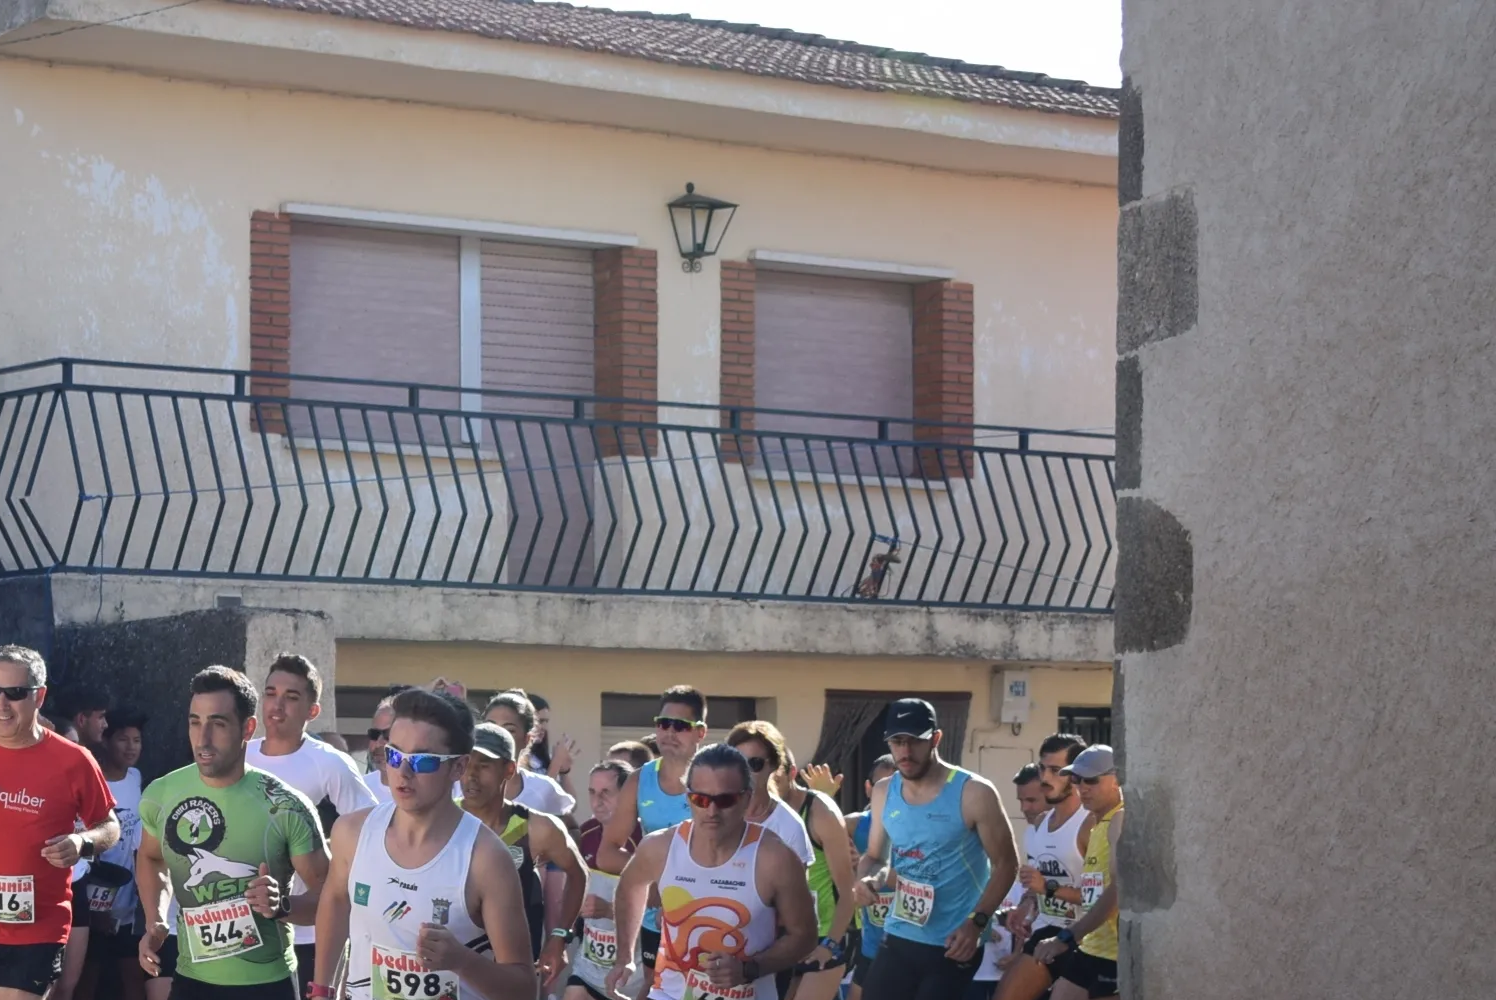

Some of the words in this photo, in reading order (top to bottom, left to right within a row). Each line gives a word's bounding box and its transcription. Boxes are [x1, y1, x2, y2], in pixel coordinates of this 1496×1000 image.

[189, 800, 221, 825] RACERS
[185, 904, 250, 927] bedunia
[902, 894, 925, 914] 633
[200, 921, 243, 947] 544
[590, 940, 616, 959] 639
[387, 970, 440, 996] 598
